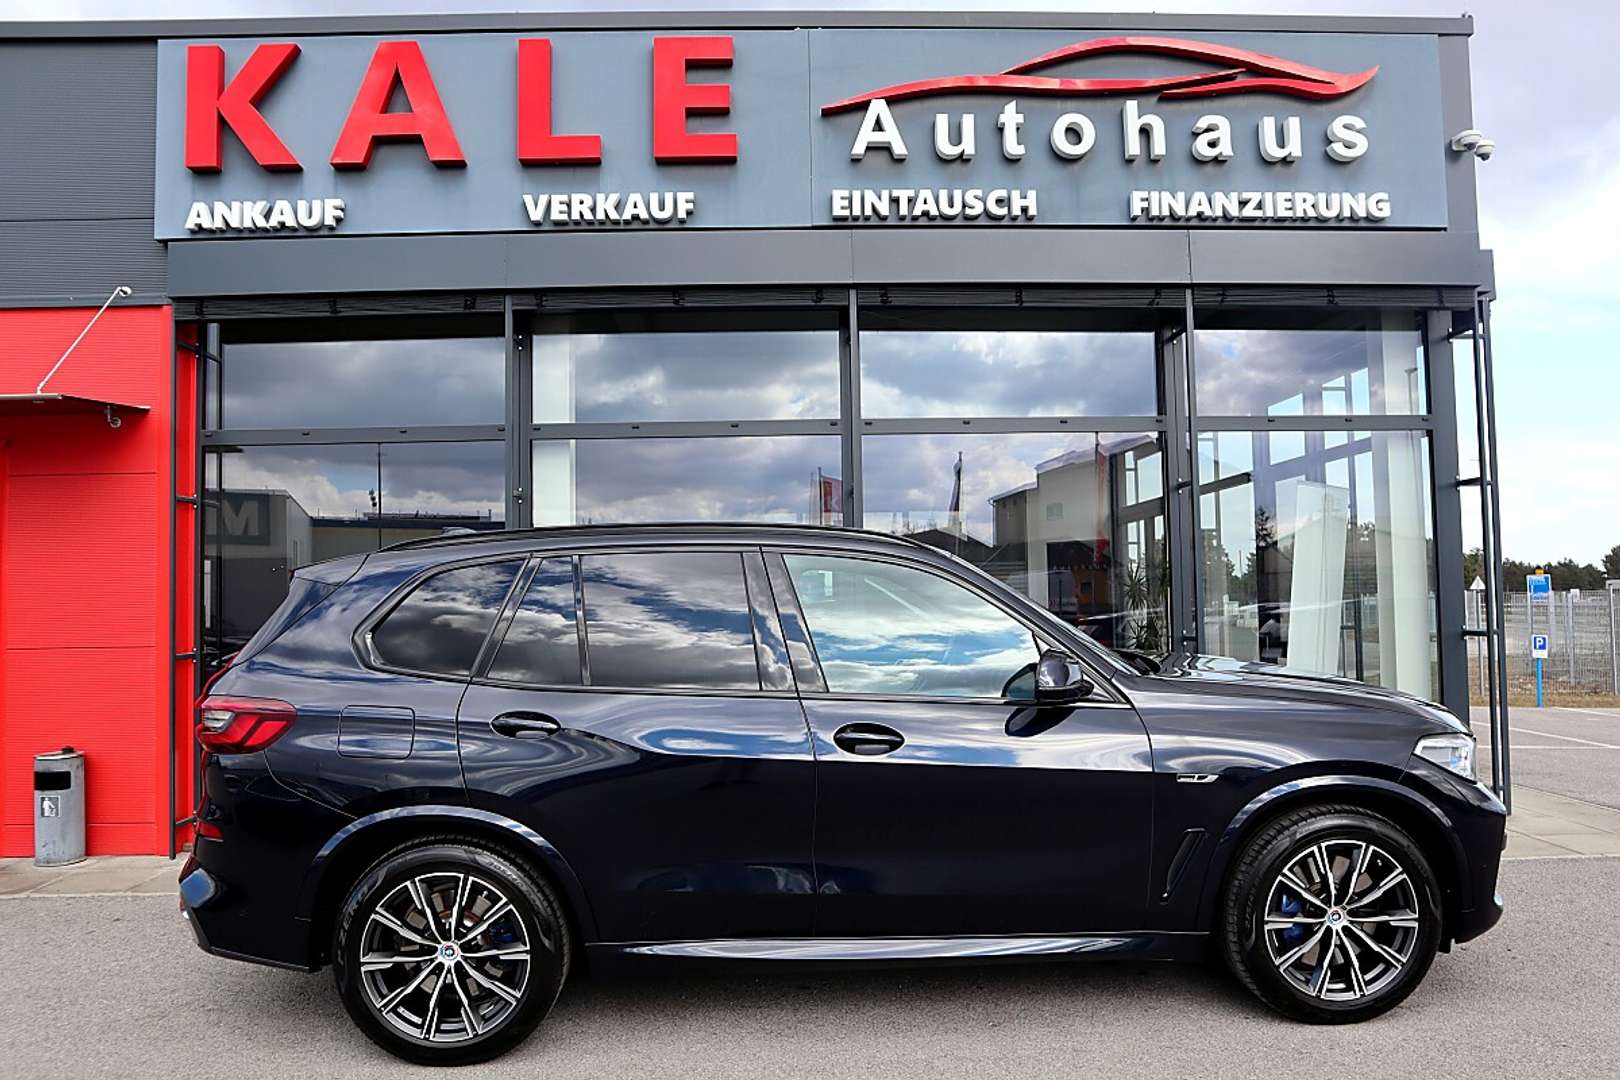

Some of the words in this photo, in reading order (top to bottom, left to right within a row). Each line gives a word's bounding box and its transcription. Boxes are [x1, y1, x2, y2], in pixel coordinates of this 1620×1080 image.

[185, 37, 739, 174] KALE
[851, 99, 1370, 162] Autohaus
[184, 198, 345, 232] ANKAUF
[522, 191, 696, 224] VERKAUF
[831, 188, 1038, 219] EINTAUSCH
[1130, 190, 1393, 220] FINANZIERUNG
